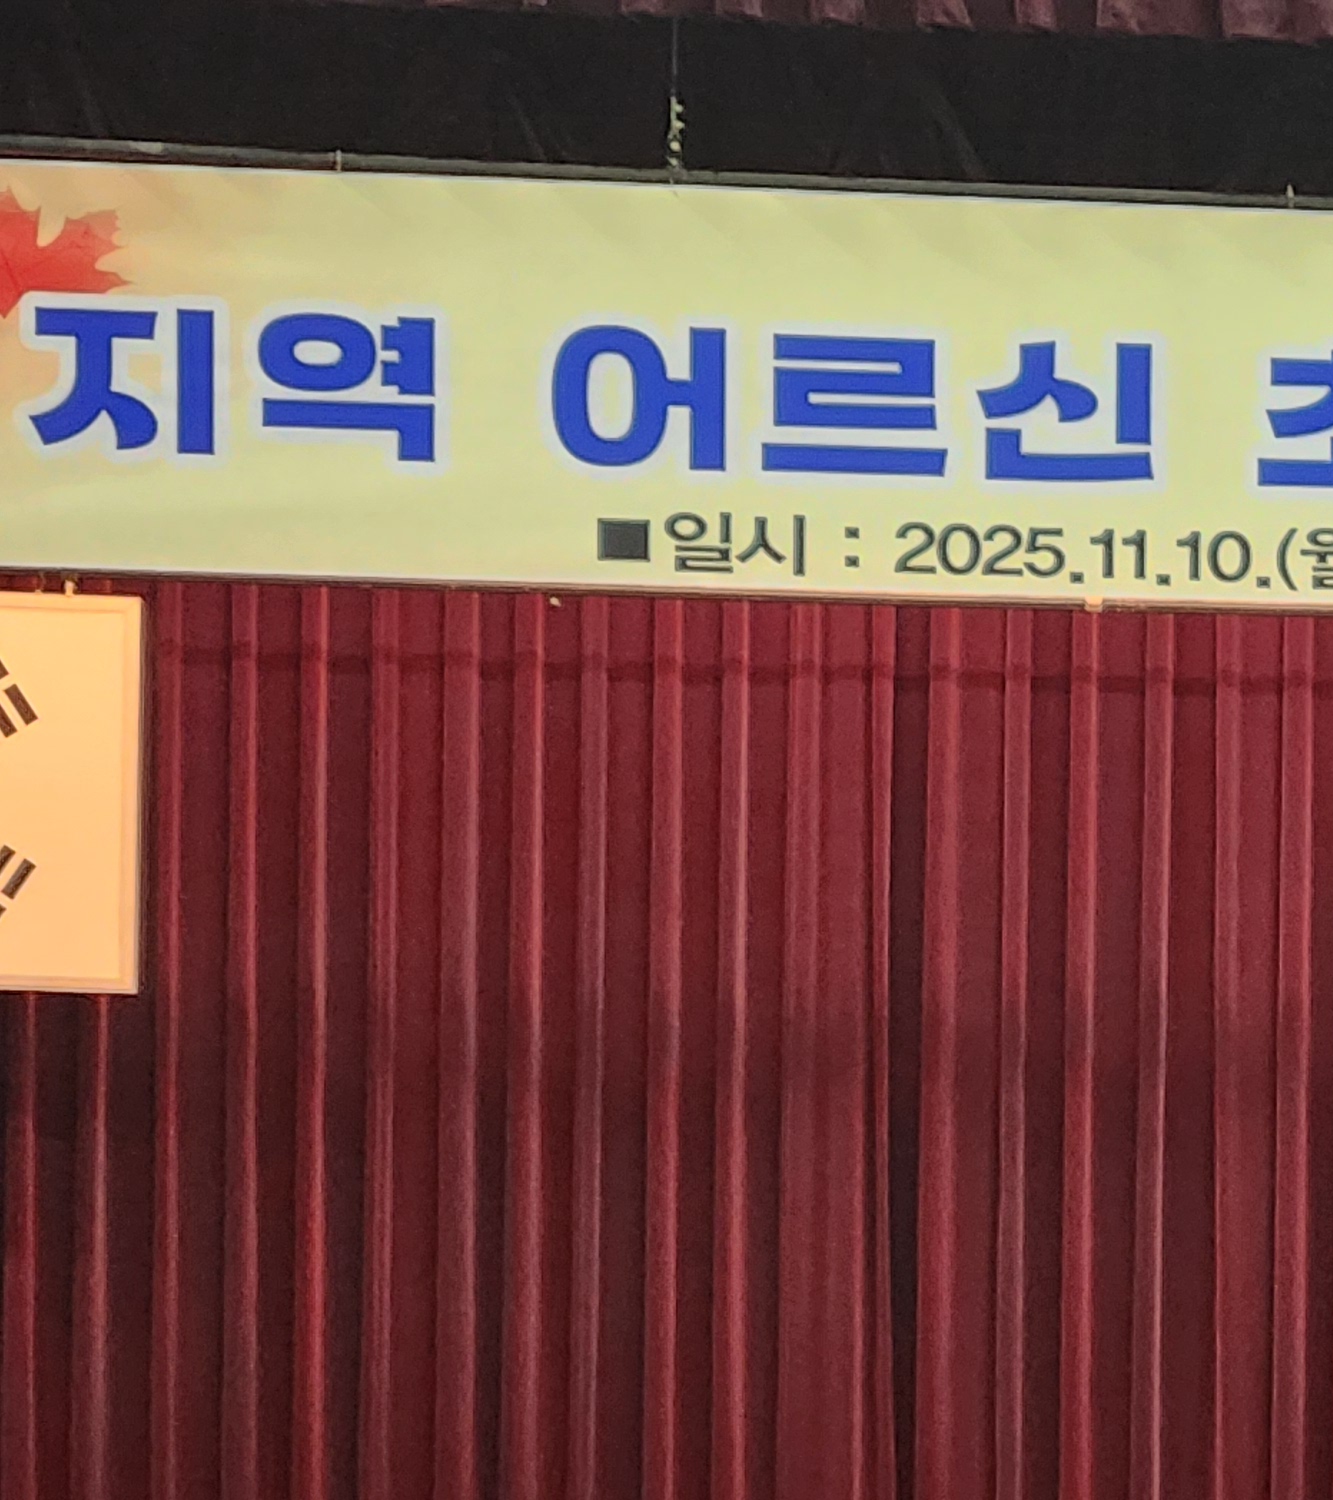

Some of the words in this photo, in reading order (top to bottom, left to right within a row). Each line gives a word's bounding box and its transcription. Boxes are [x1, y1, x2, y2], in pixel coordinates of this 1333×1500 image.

[30, 305, 435, 463] 지역
[551, 324, 1154, 482] 어르신
[663, 511, 807, 577] 일시
